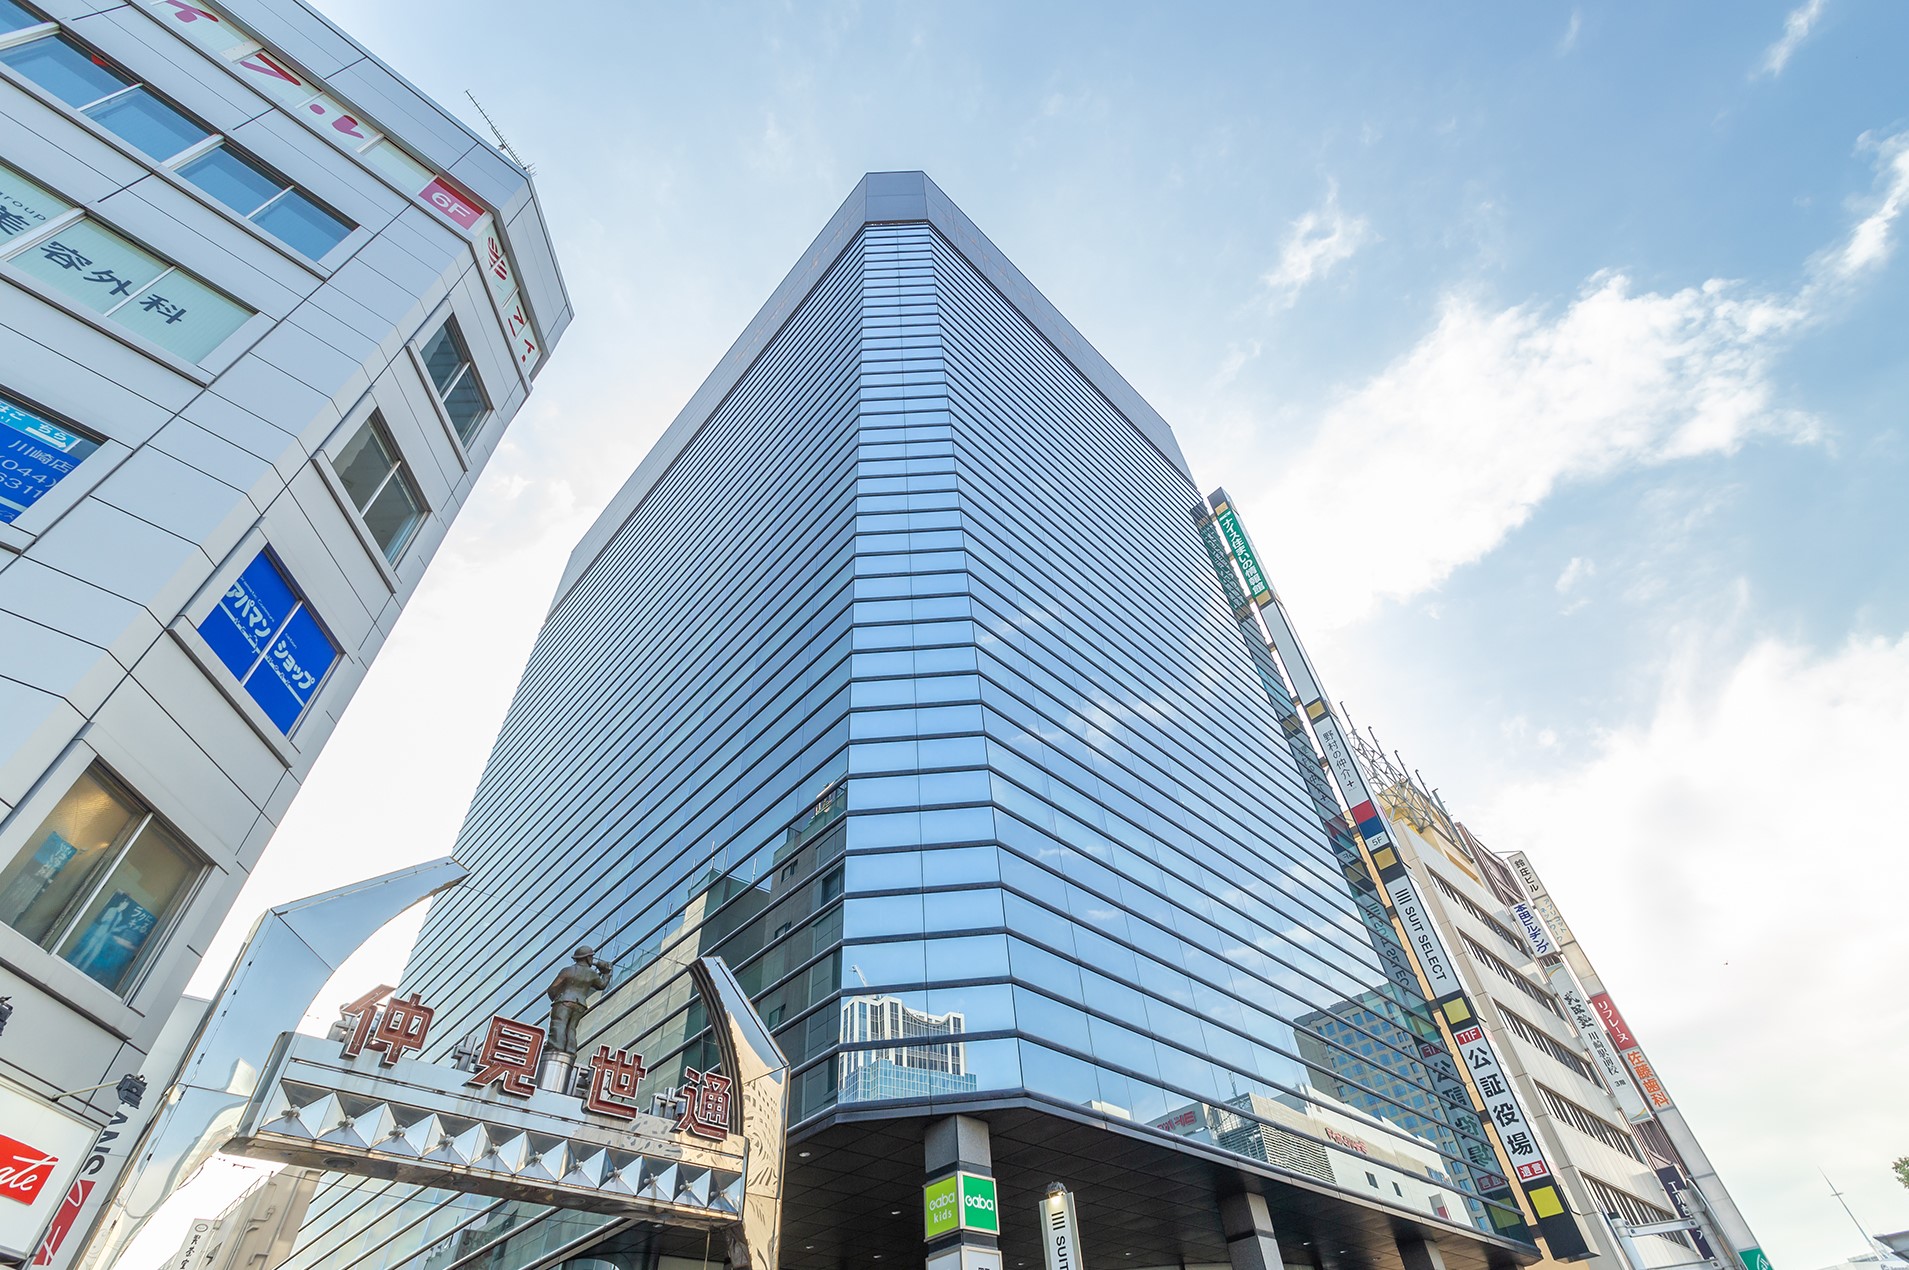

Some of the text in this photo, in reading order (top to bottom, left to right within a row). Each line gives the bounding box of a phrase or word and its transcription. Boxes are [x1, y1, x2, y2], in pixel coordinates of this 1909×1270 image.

[431, 191, 471, 220] 6F
[8, 439, 75, 474] 川崎店
[225, 581, 316, 689] アパマンショップ
[1404, 906, 1447, 982] SUIT SELECT
[1459, 1028, 1478, 1044] 11F
[1598, 1000, 1629, 1043] リフレーヌ
[340, 984, 733, 1142] 仲見世通
[1627, 1050, 1670, 1108] 佐藤歯科
[1468, 1047, 1534, 1157] 公証役場
[933, 1208, 952, 1224] kids
